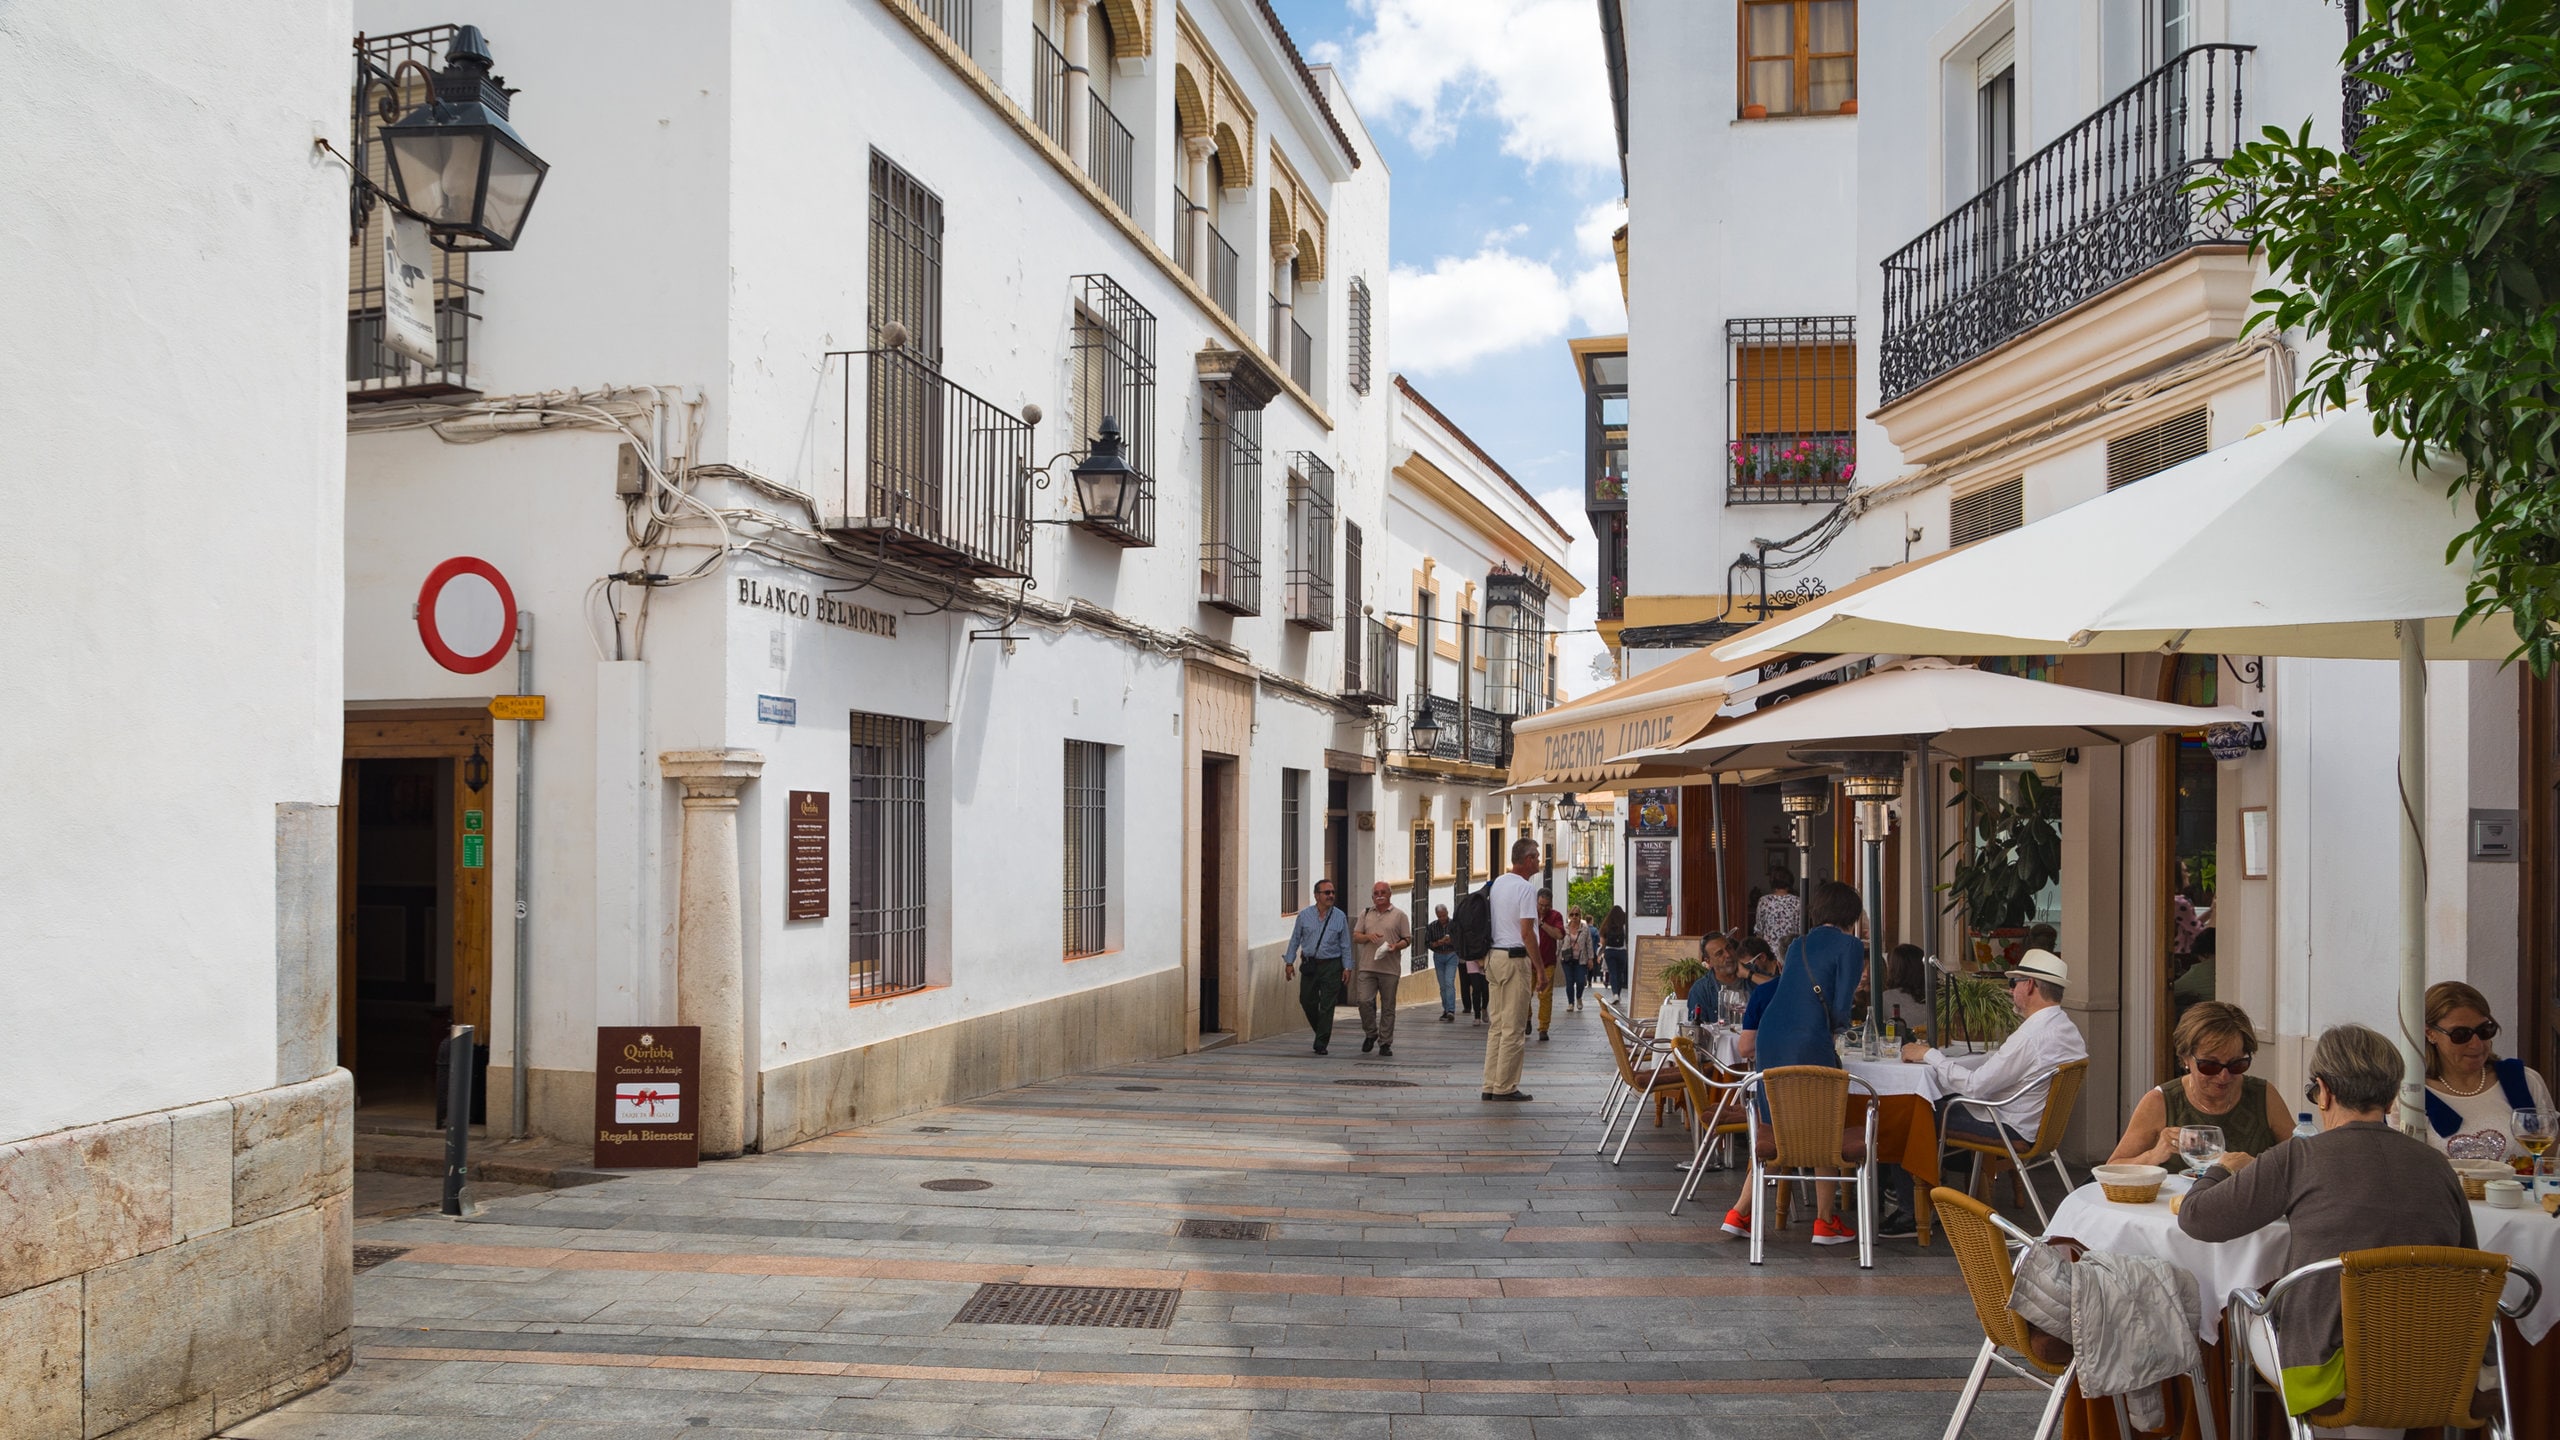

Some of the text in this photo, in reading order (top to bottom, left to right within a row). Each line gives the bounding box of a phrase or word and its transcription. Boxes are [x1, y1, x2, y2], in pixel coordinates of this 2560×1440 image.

[738, 578, 897, 639] BLANCO BELMONTE
[1544, 727, 1606, 771] TABERNA
[614, 1066, 683, 1076] Centro de Masaje
[600, 1130, 695, 1145] Regala Bienestar
